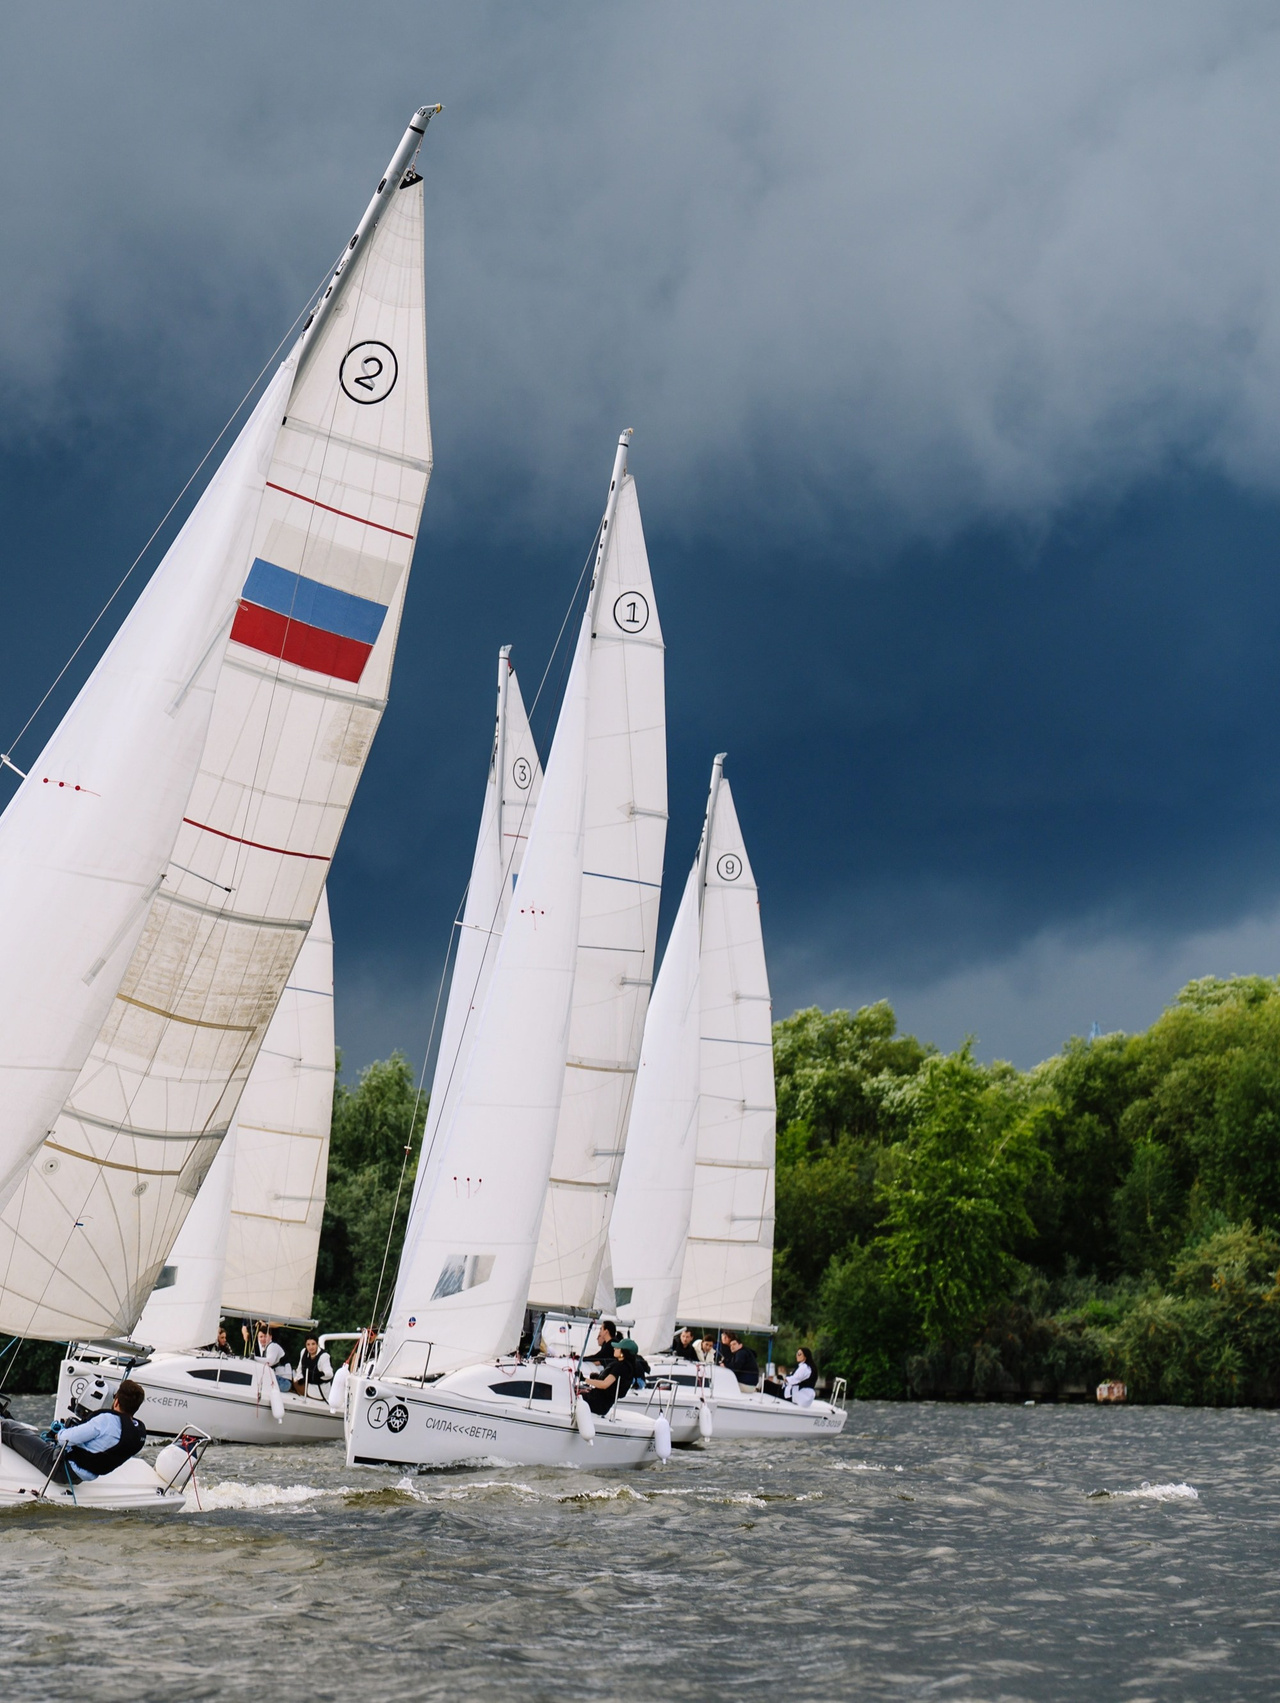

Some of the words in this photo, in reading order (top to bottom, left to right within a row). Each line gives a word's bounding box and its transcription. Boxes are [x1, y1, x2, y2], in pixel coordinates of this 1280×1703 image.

[354, 357, 383, 391] 2
[626, 602, 640, 623] 1
[519, 765, 527, 781] 3
[725, 860, 735, 875] 9
[76, 1382, 85, 1395] 8
[373, 1406, 384, 1422] 1
